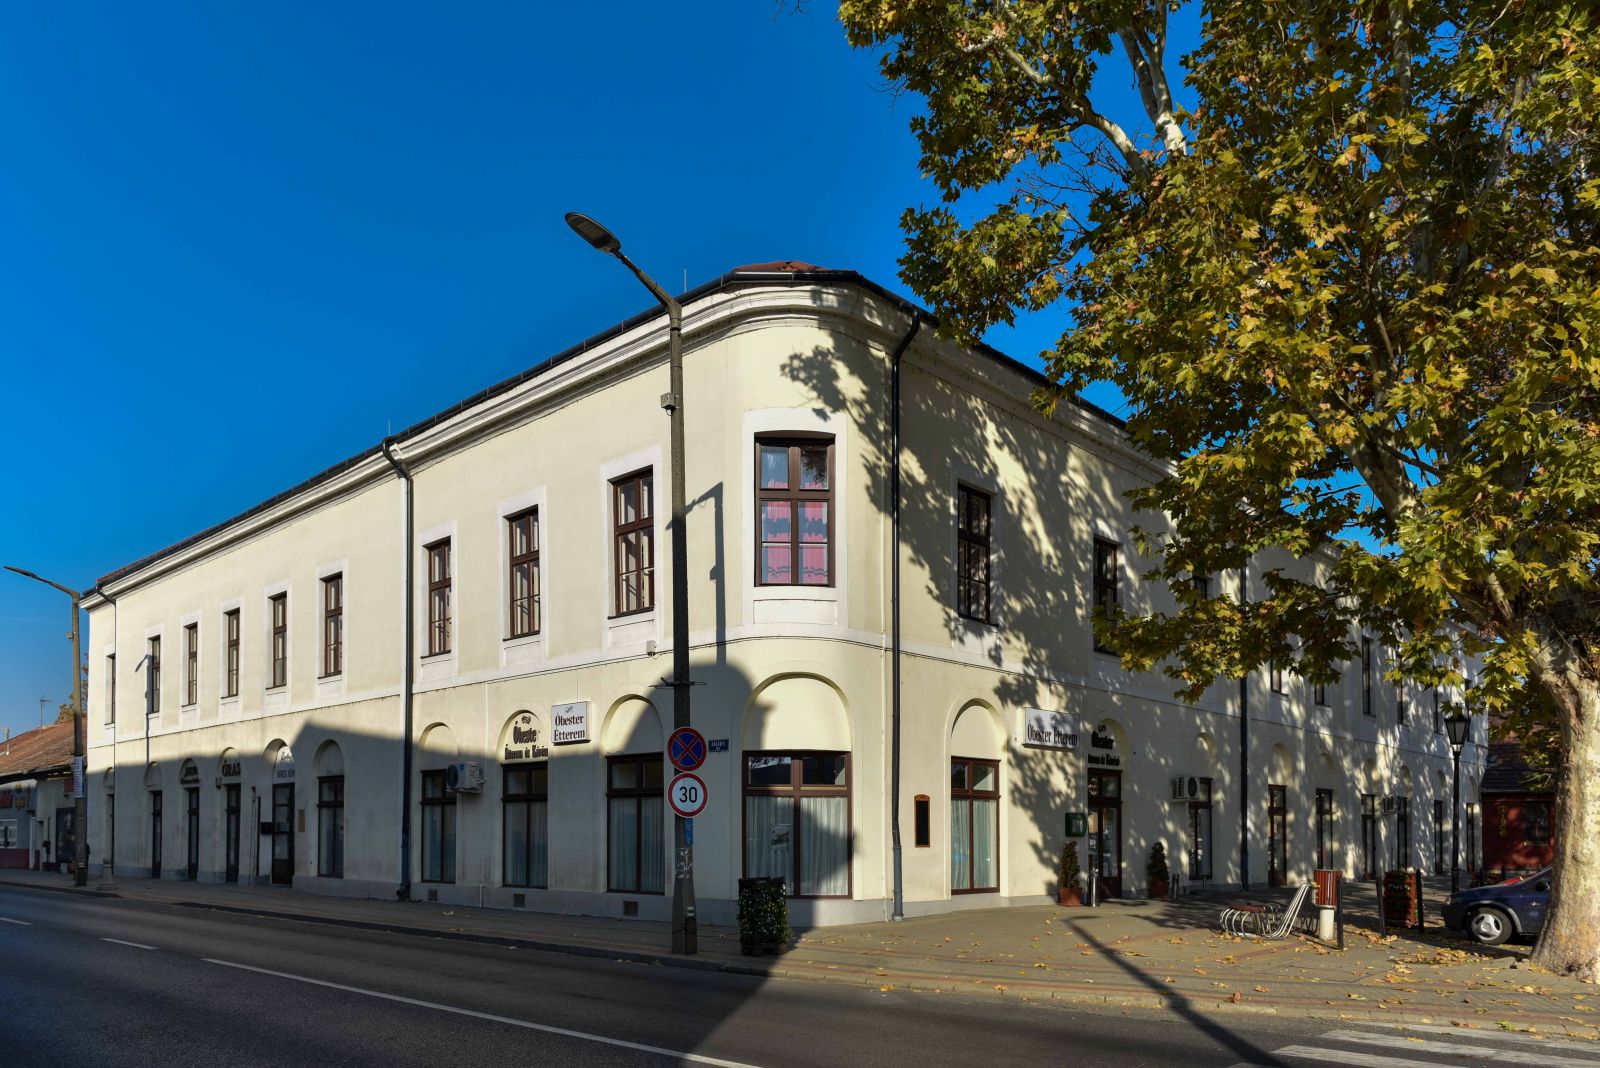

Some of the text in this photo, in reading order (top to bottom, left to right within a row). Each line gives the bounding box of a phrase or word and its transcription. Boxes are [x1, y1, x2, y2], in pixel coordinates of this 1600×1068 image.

[554, 712, 584, 727] Óbester
[553, 727, 585, 742] Étterem
[1027, 719, 1078, 746] Óbester Étterem
[679, 786, 698, 803] 30
